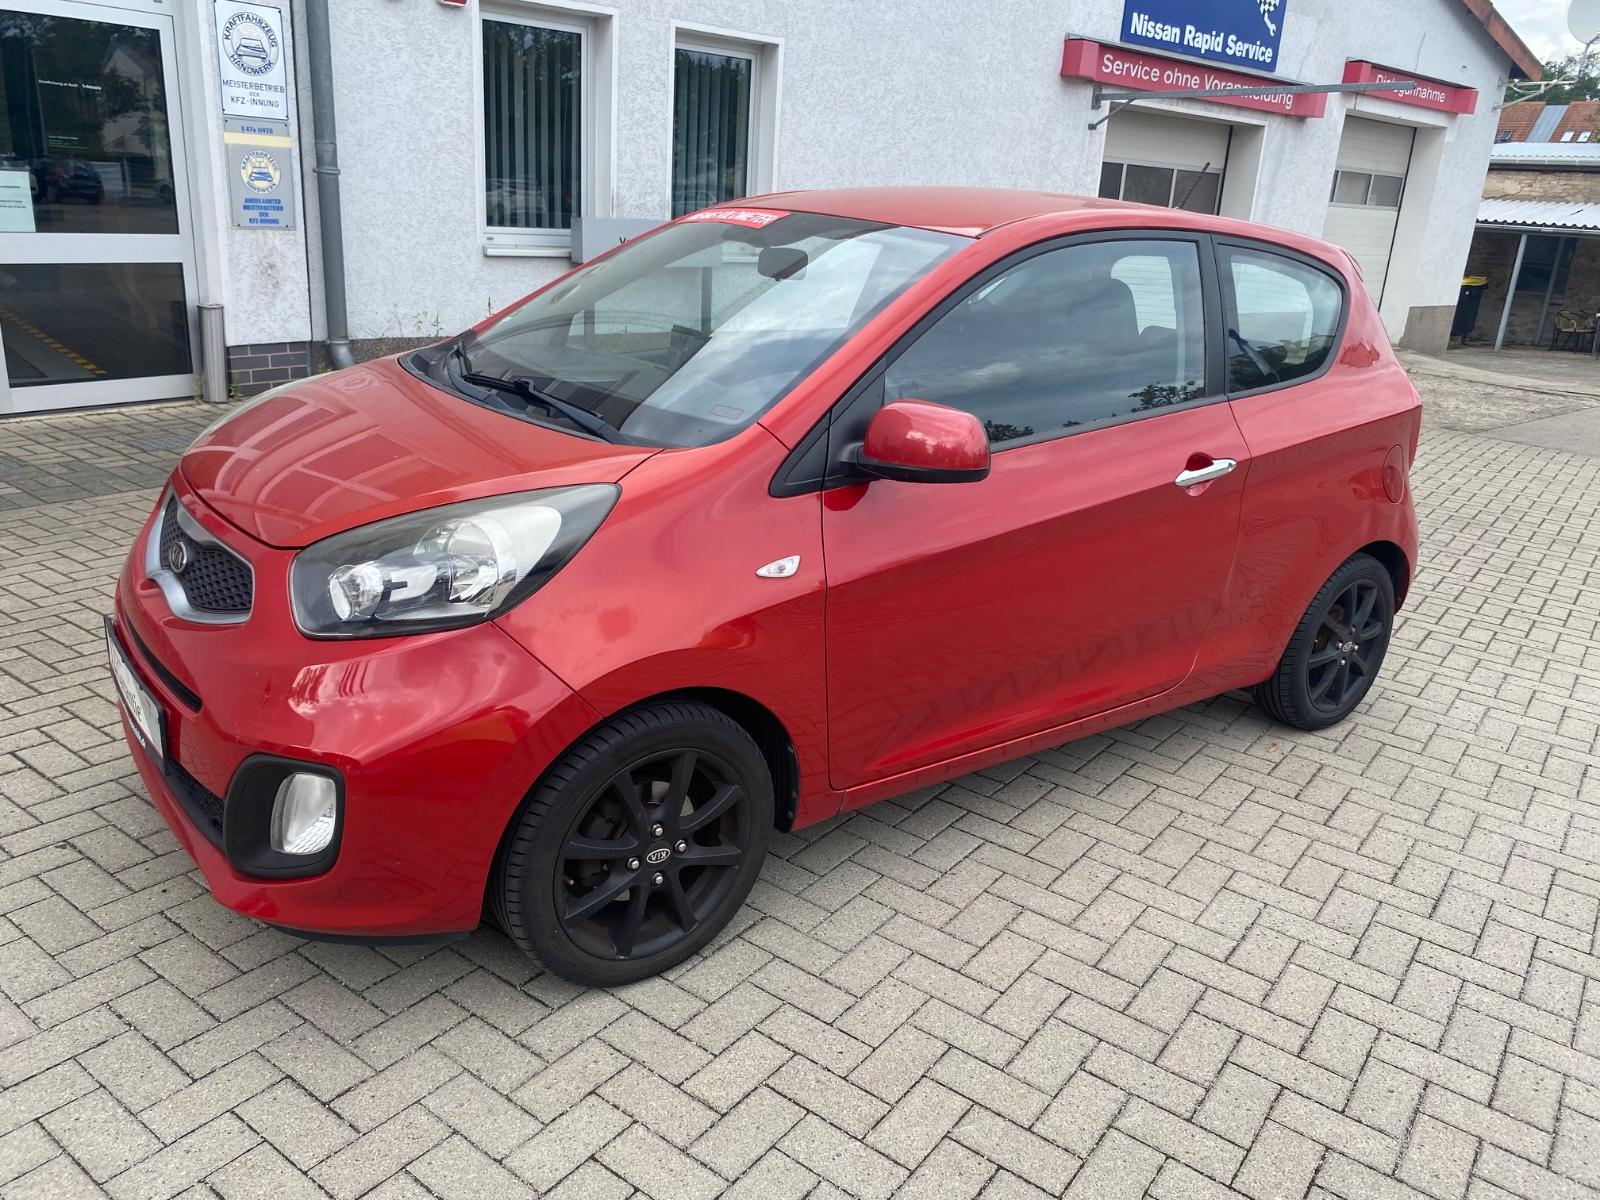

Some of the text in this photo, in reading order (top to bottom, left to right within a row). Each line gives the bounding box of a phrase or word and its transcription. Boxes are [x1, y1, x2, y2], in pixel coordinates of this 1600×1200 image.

[224, 13, 277, 48] KRAFTFAHRZEUG
[1130, 12, 1273, 64] Nissan Rapid Service
[229, 53, 275, 75] HANDWERK
[1101, 53, 1160, 82] Service
[1163, 68, 1200, 88] ohne
[222, 79, 285, 94] MEISTERBETRIEB
[651, 851, 666, 860] KIA
